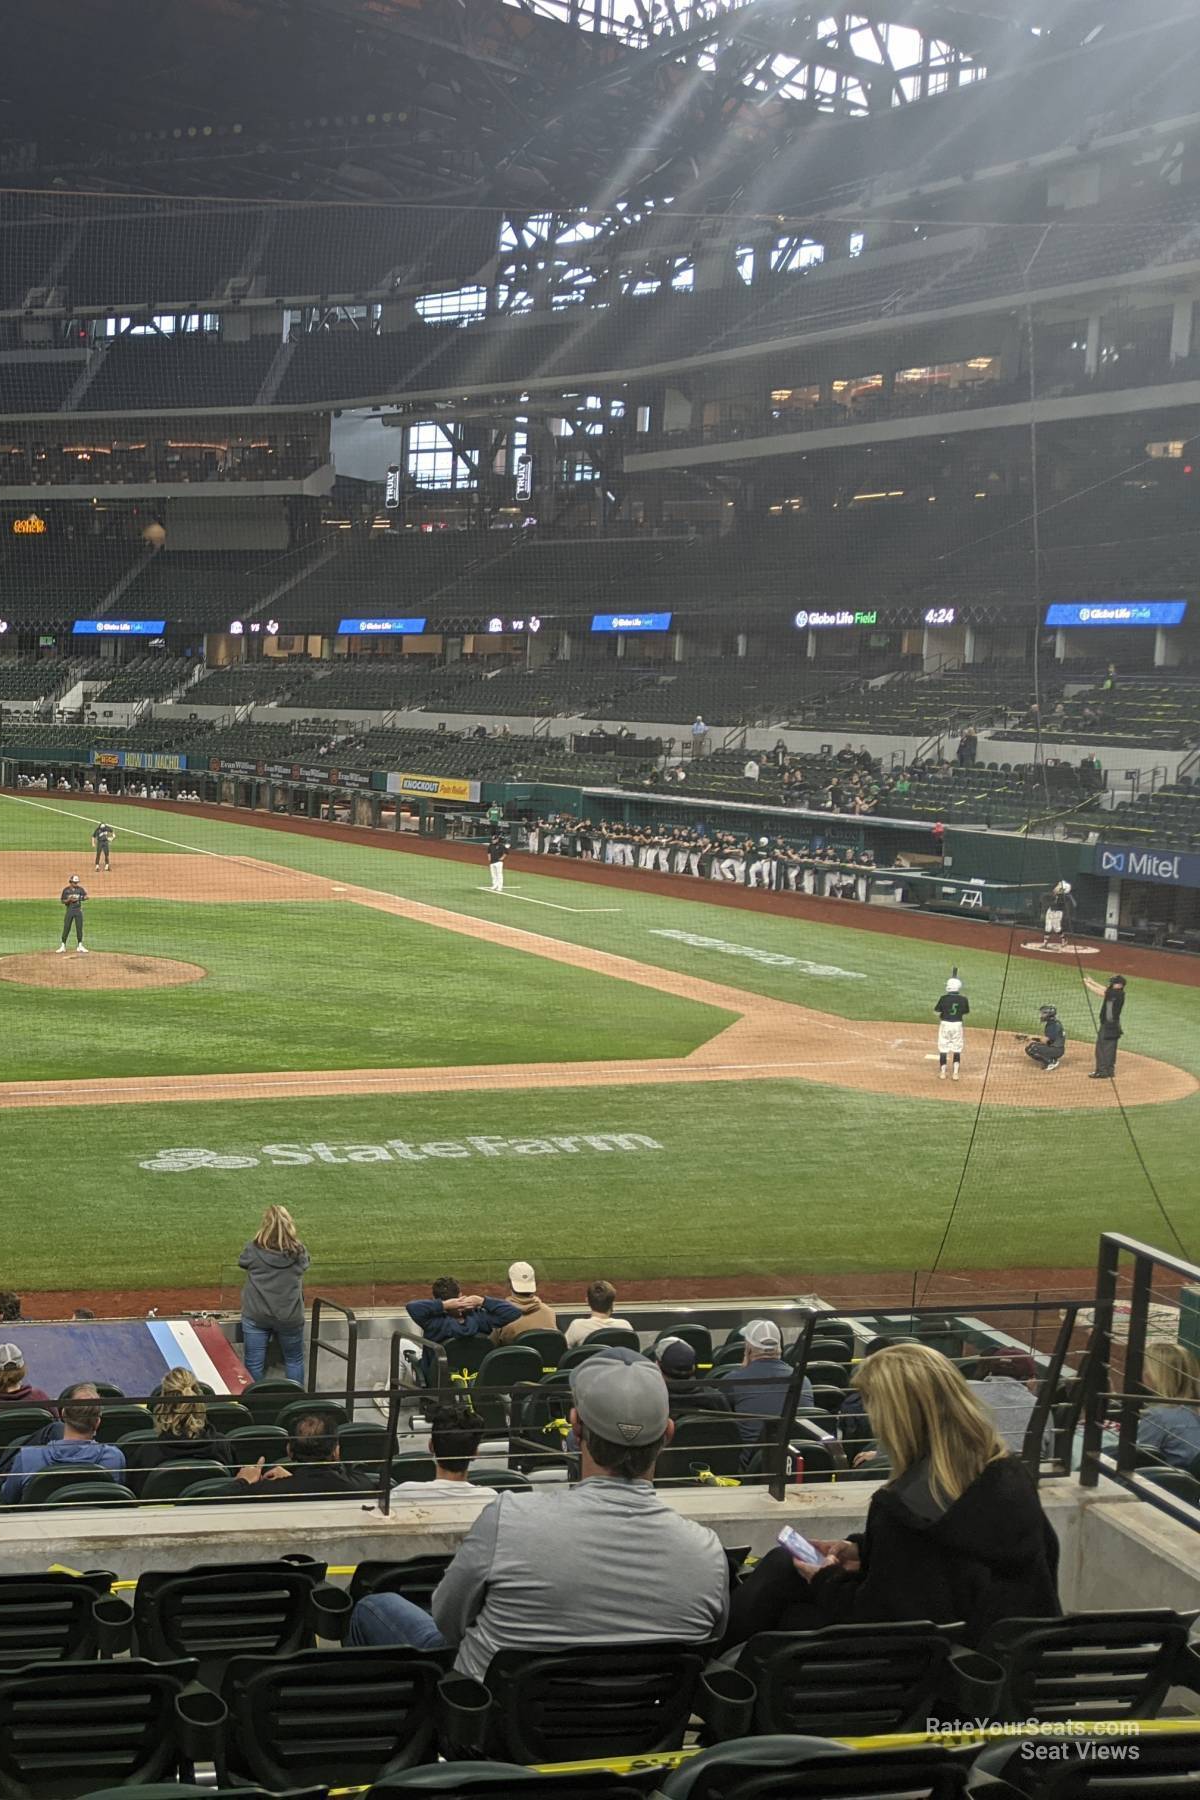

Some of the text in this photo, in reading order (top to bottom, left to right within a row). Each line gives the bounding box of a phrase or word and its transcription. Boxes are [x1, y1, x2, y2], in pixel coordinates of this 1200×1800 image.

[517, 463, 526, 492] TRULY
[386, 472, 395, 500] TRULY
[809, 611, 876, 625] Globe Life Field
[925, 608, 955, 623] 4:24
[125, 752, 179, 769] HOW TO NACHO
[403, 779, 439, 792] KNOCKOUT
[1128, 853, 1180, 879] Mitel
[949, 1003, 960, 1016] 5
